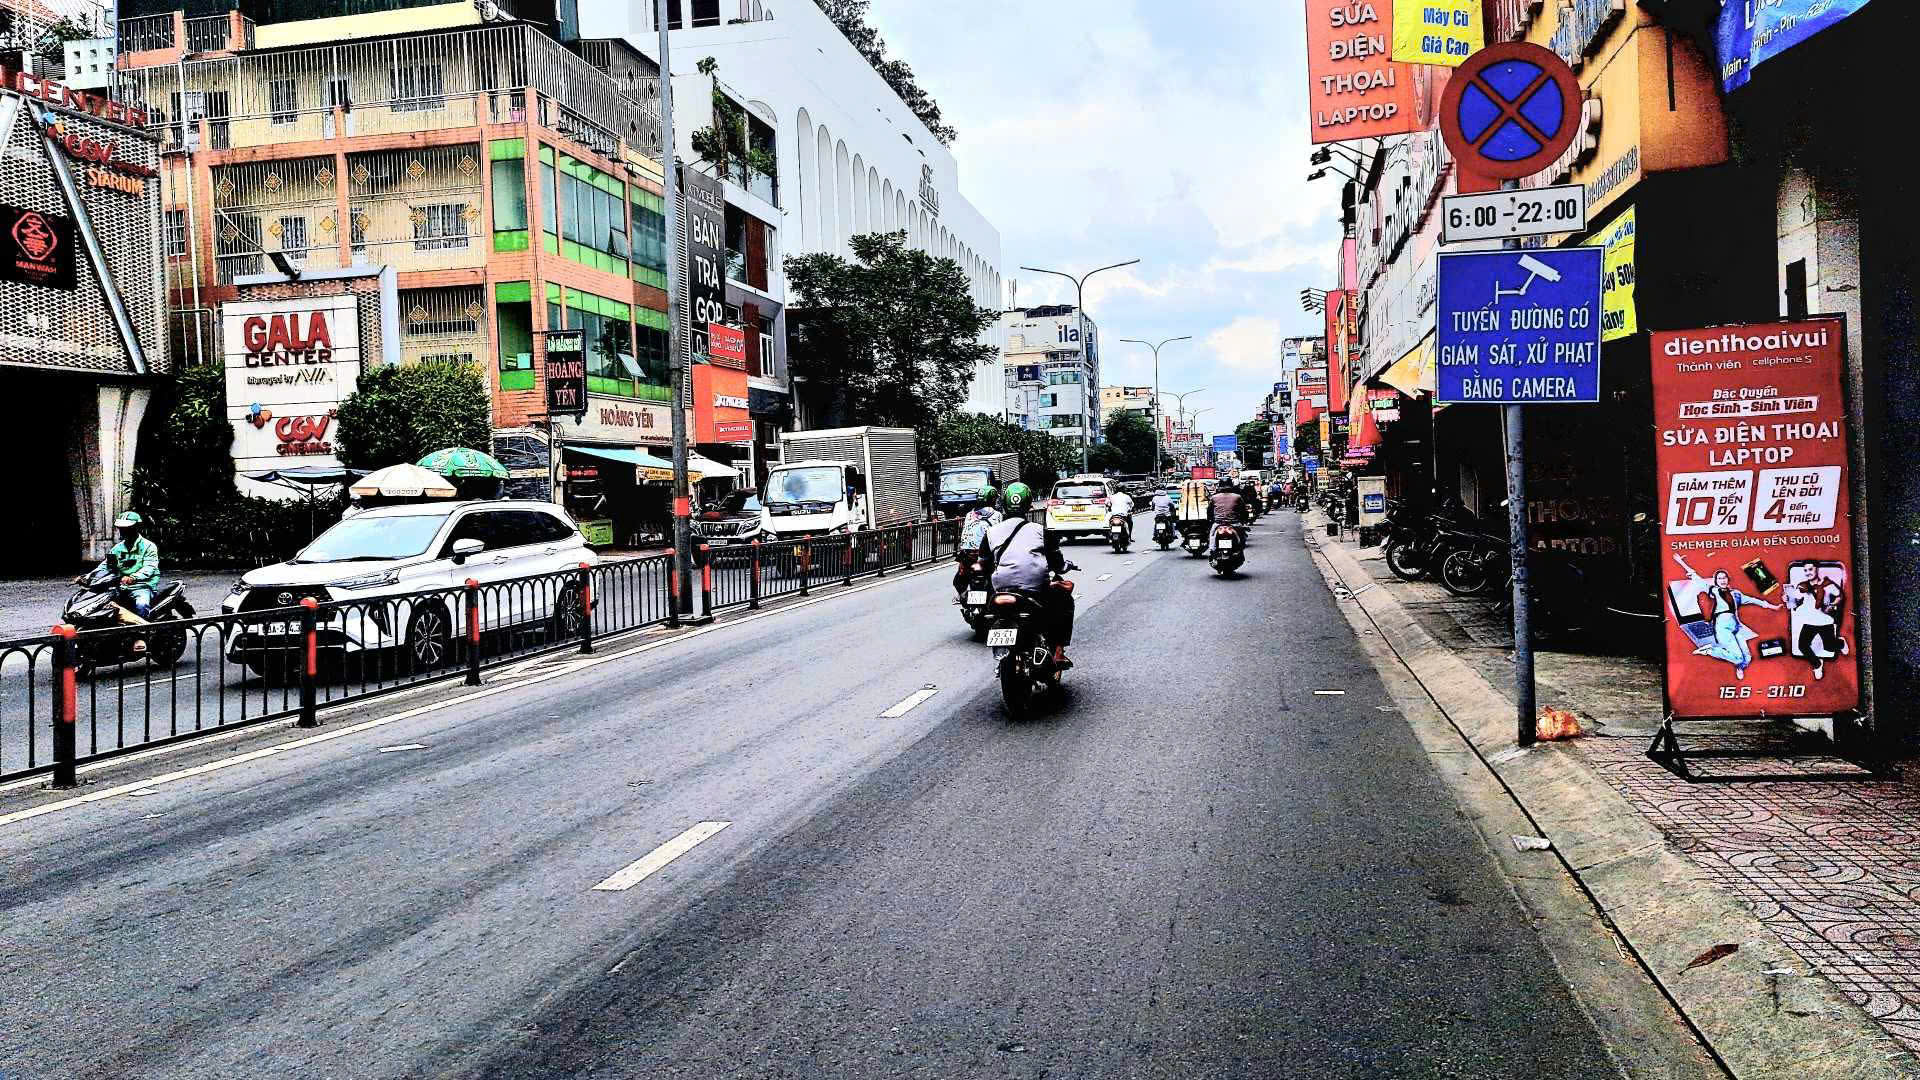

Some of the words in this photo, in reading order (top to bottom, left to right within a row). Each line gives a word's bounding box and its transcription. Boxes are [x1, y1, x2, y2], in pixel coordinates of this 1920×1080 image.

[1329, 0, 1378, 27] SỬA
[1423, 7, 1450, 27] Máy
[1453, 9, 1469, 27] Cũ
[1329, 32, 1385, 63] ĐIỆN
[1421, 35, 1442, 54] Giá
[1446, 37, 1470, 56] Cao
[16, 71, 149, 127] CENTER
[1318, 102, 1399, 127] LAPTOP
[64, 134, 116, 164] CGV
[87, 167, 145, 195] STARIUM
[1449, 205, 1497, 229] 6:00
[1517, 198, 1577, 223] 22:00
[693, 211, 719, 251] BÁN
[695, 253, 720, 290] TRẢ
[696, 292, 723, 324] GÓP
[1452, 301, 1500, 331] TUYẾN
[1510, 302, 1564, 330] ĐƯỜNG
[1569, 301, 1589, 329] CÓ
[244, 311, 332, 352] GALA
[1058, 324, 1080, 343] ila
[1664, 328, 1827, 356] dienthoaivui
[245, 349, 333, 368] CENTER
[1441, 339, 1479, 366] GIÁM
[1489, 337, 1522, 366] SÁT,
[1527, 336, 1549, 364] XỬ
[1555, 342, 1595, 367] PHẠT
[547, 357, 582, 379] HOÀNG
[1677, 361, 1713, 372] Thành
[1716, 359, 1742, 370] viên
[555, 381, 576, 406] YẾN
[1463, 369, 1503, 399] BẰNG
[1512, 377, 1577, 398] CAMERA
[600, 404, 634, 427] HOÀNG
[635, 407, 654, 429] YẾN
[1683, 405, 1708, 417] Học
[1712, 402, 1741, 414] Sinh
[1751, 400, 1780, 412] Sinh
[1783, 398, 1813, 410] Viên
[275, 415, 331, 442] CGV
[1663, 424, 1709, 446] SỬA
[1714, 421, 1766, 447] ĐIỆN
[1771, 421, 1839, 442] THOẠI
[1709, 446, 1794, 466] LAPTOP
[1677, 478, 1708, 491] GIẢM
[1712, 477, 1746, 490] THÊM
[1771, 486, 1797, 498] LÊN
[1800, 485, 1823, 497] ĐỜI
[1774, 476, 1799, 486] THU
[1802, 472, 1820, 485] CŨ
[1719, 492, 1743, 504] ĐẾN
[1764, 499, 1786, 524] 4
[1787, 512, 1821, 525] TRIỆU
[1671, 539, 1728, 550] SMEMBER
[1731, 536, 1760, 548] GIẢM
[1763, 534, 1787, 546] ĐẾN
[1719, 686, 1752, 699] 15.6
[1767, 685, 1806, 698] 31.10
